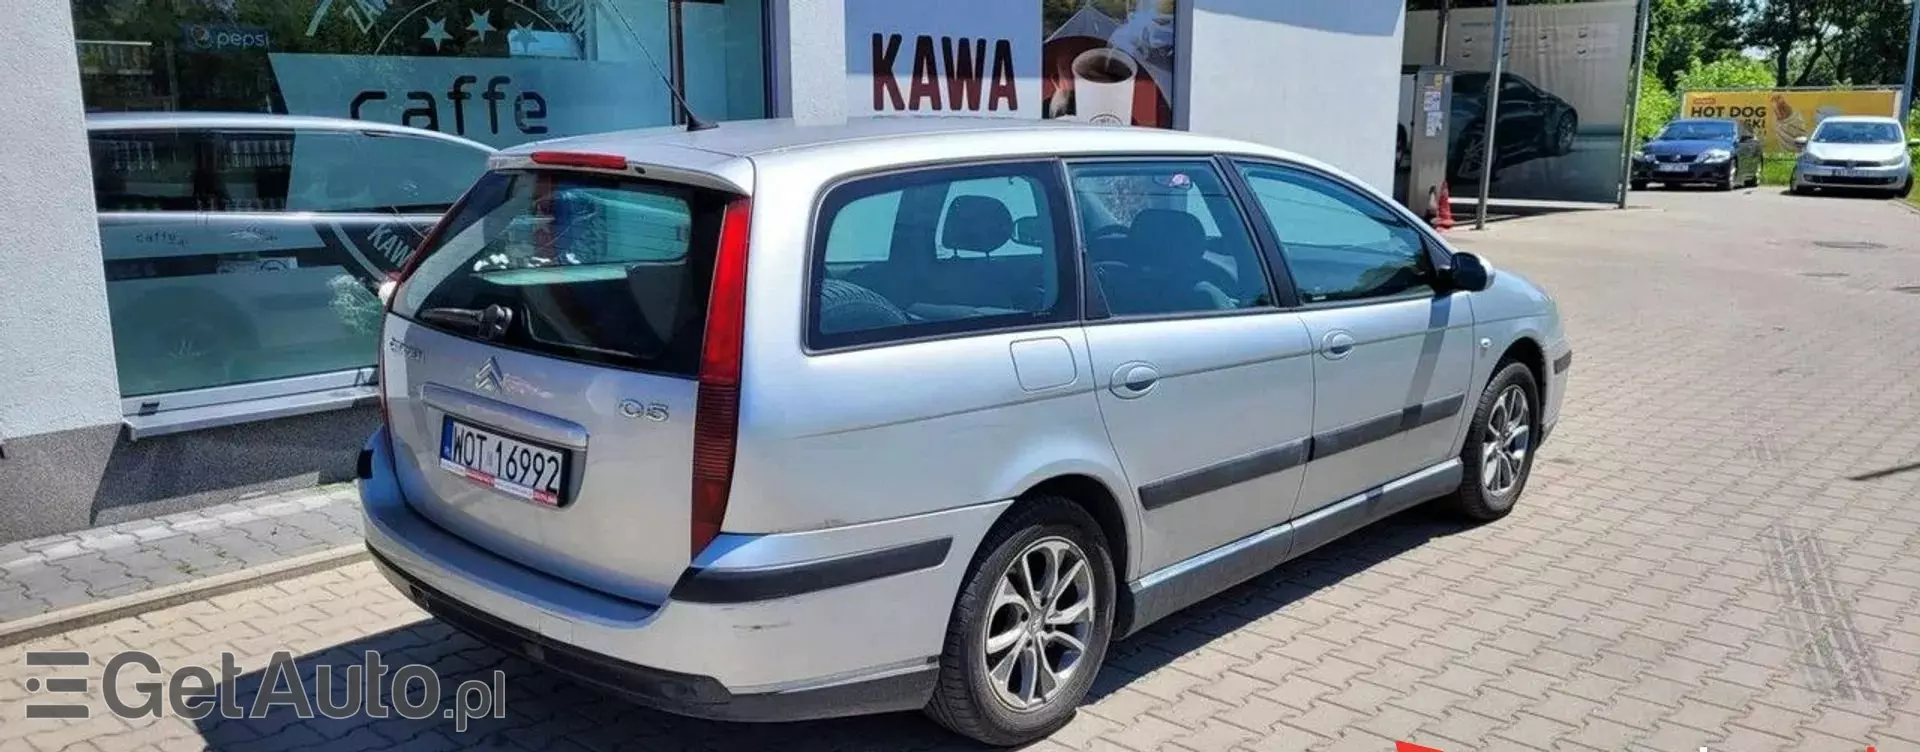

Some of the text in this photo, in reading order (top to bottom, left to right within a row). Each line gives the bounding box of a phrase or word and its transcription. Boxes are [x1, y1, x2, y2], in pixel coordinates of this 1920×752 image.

[217, 31, 269, 49] pepsi
[872, 33, 1018, 111] KAWA
[350, 75, 548, 136] caffe
[1691, 106, 1766, 118] HOT DOG
[618, 398, 670, 422] C5
[453, 426, 488, 471] WOT
[495, 440, 560, 494] 16992
